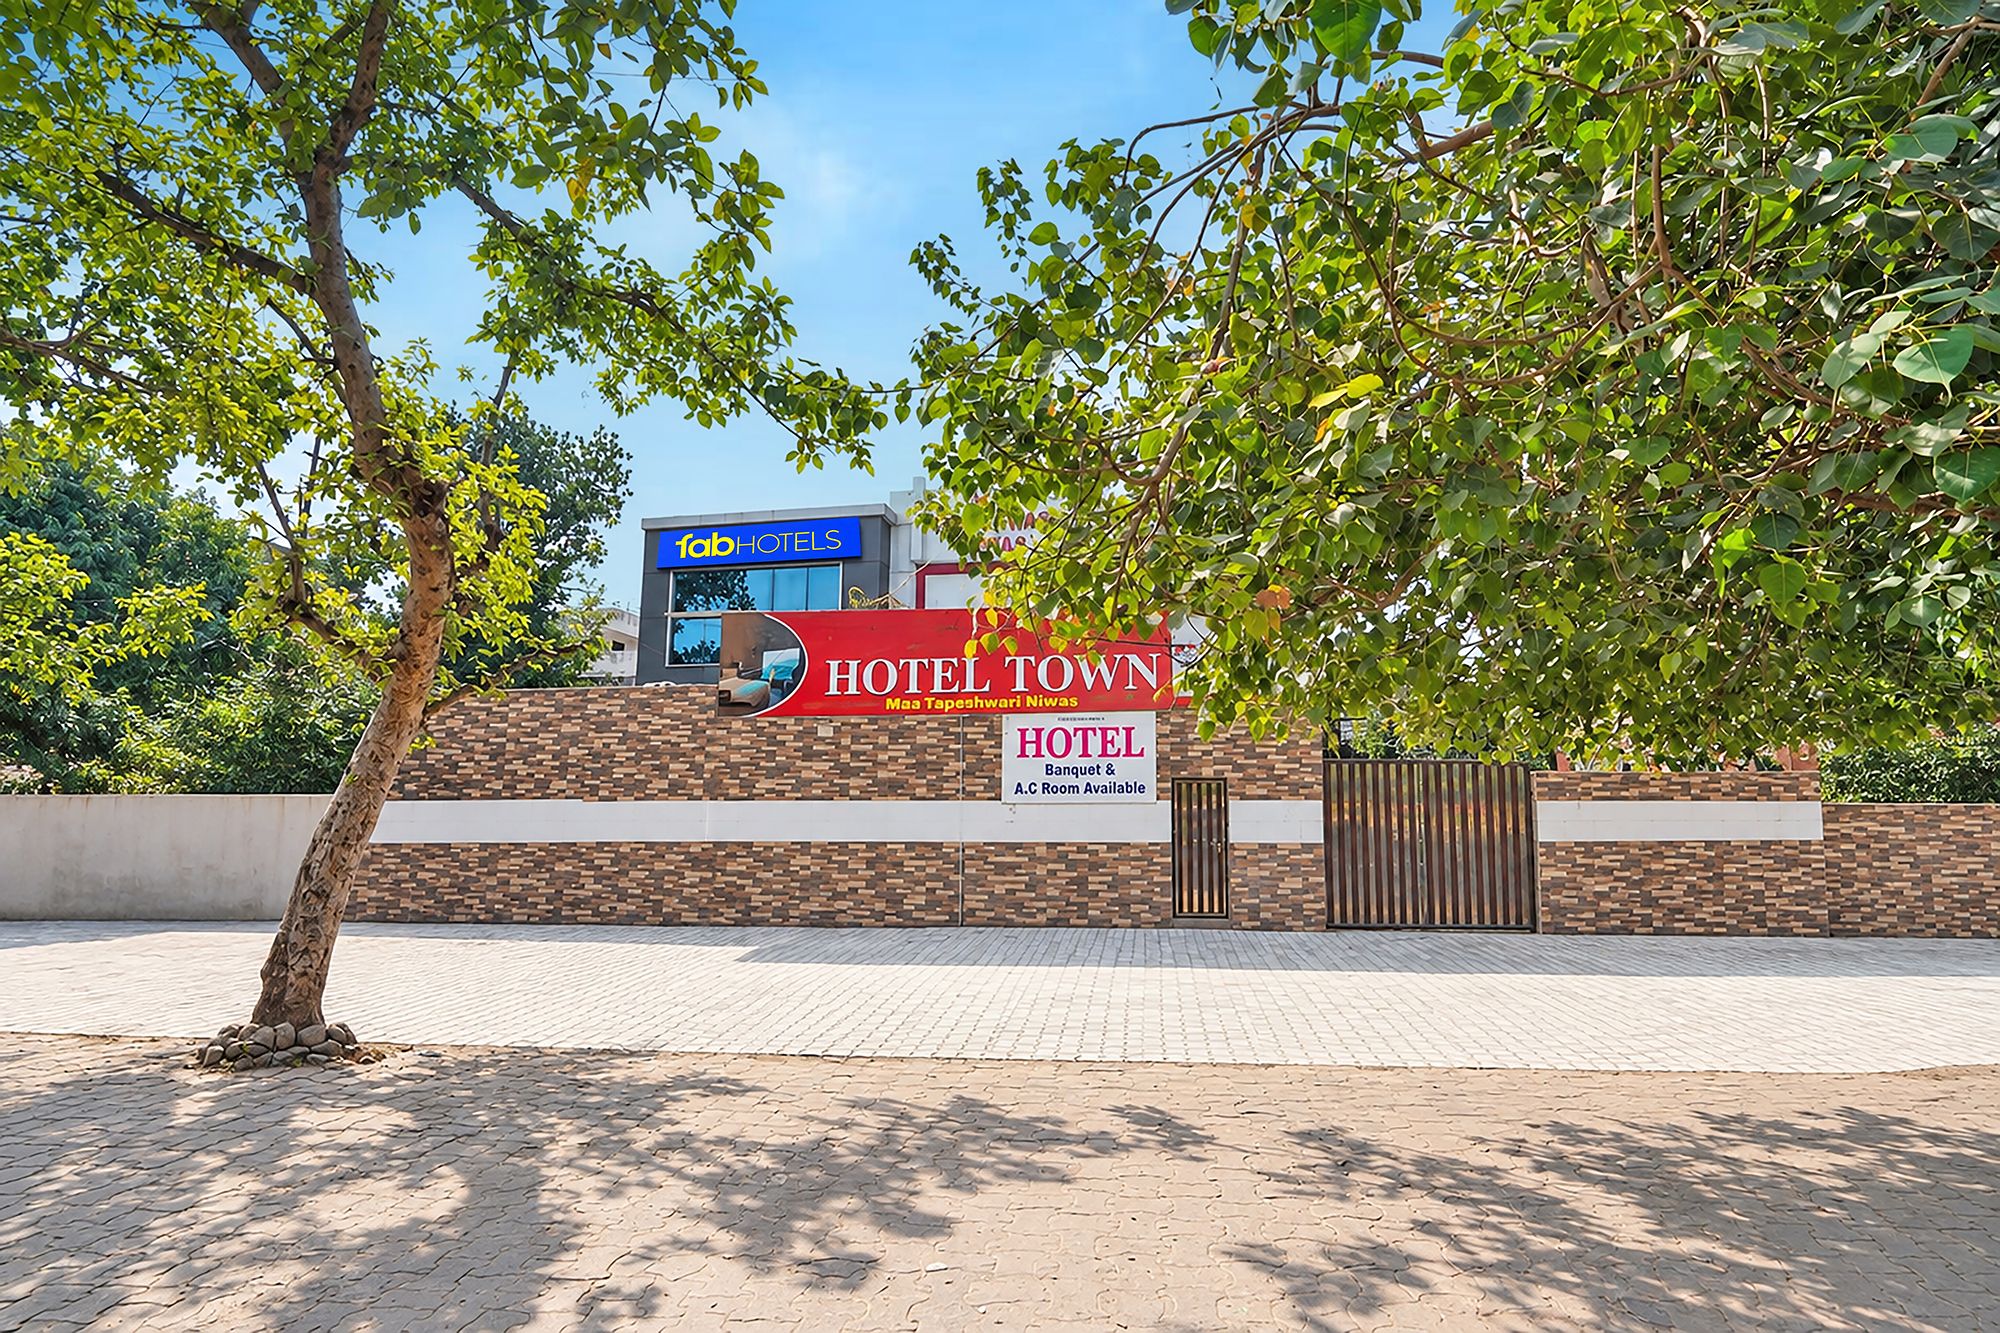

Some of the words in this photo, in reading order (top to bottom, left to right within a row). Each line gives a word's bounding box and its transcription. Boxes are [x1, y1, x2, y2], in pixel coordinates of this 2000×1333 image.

[824, 657, 991, 695] HOTEL
[1004, 653, 1161, 692] TOWN
[885, 698, 921, 710] Maa
[924, 696, 1021, 712] Tapeshwari
[1026, 695, 1079, 708] Niwas
[1016, 726, 1145, 759] HOTEL
[1045, 763, 1102, 778] Banquet
[1105, 763, 1116, 776] &
[1014, 782, 1037, 795] A.C
[1041, 782, 1080, 795] Room
[1083, 781, 1146, 794] Available
